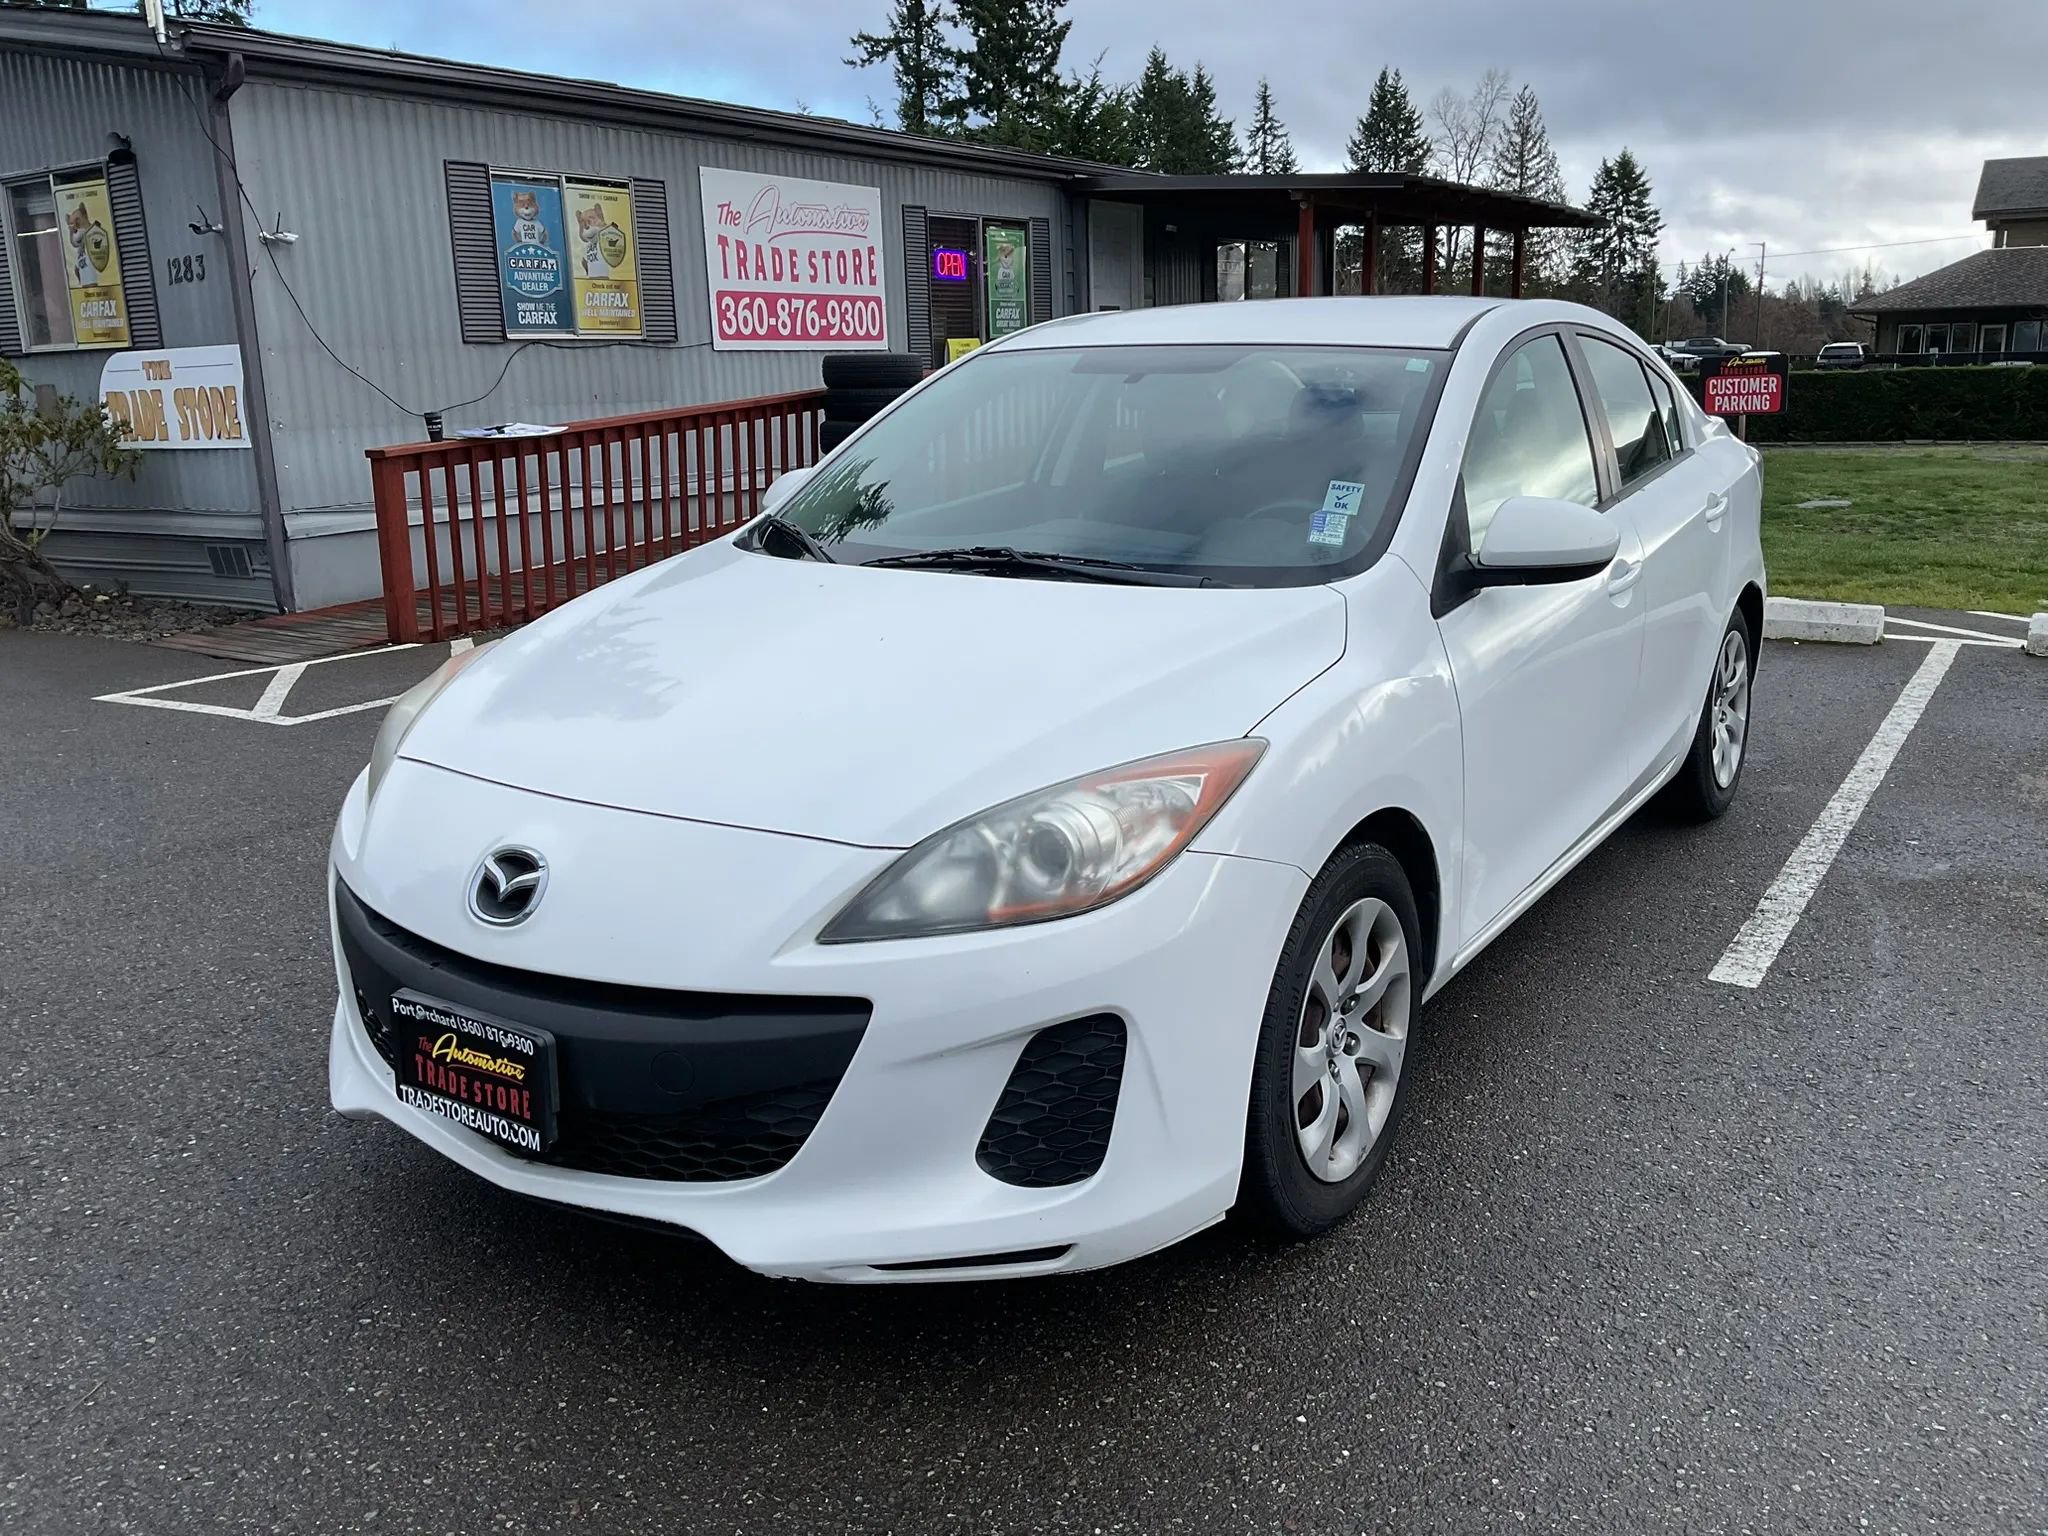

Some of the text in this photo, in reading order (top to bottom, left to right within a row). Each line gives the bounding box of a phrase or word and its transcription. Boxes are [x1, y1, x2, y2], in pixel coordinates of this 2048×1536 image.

[717, 184, 869, 234] The Automotive
[524, 232, 536, 240] FOX
[510, 259, 557, 270] CARFAX
[717, 234, 877, 286] TRADE STORE
[937, 252, 965, 276] OPEN
[167, 254, 206, 286] 1283
[514, 272, 554, 282] ADVANTAGE
[522, 283, 549, 291] DEALER
[80, 300, 117, 318] CARFAX
[517, 303, 556, 312] SHOW ME THE
[585, 292, 629, 308] CARFAX
[518, 312, 558, 325] CARFAX
[721, 296, 881, 336] 360-876-9300
[996, 308, 1020, 320] CARFAX
[142, 360, 172, 381] THE
[1709, 377, 1777, 395] CUSTOMER
[1714, 394, 1770, 412] PARKING
[106, 386, 242, 442] TRADE STORE
[1331, 484, 1362, 492] SAFETY
[392, 998, 534, 1056] Port Orchard (360) 8769300
[418, 1034, 525, 1080] The Automotive
[416, 1054, 531, 1120] TRADE STORE
[400, 1085, 540, 1151] TRADESTOREAUTO.COM
